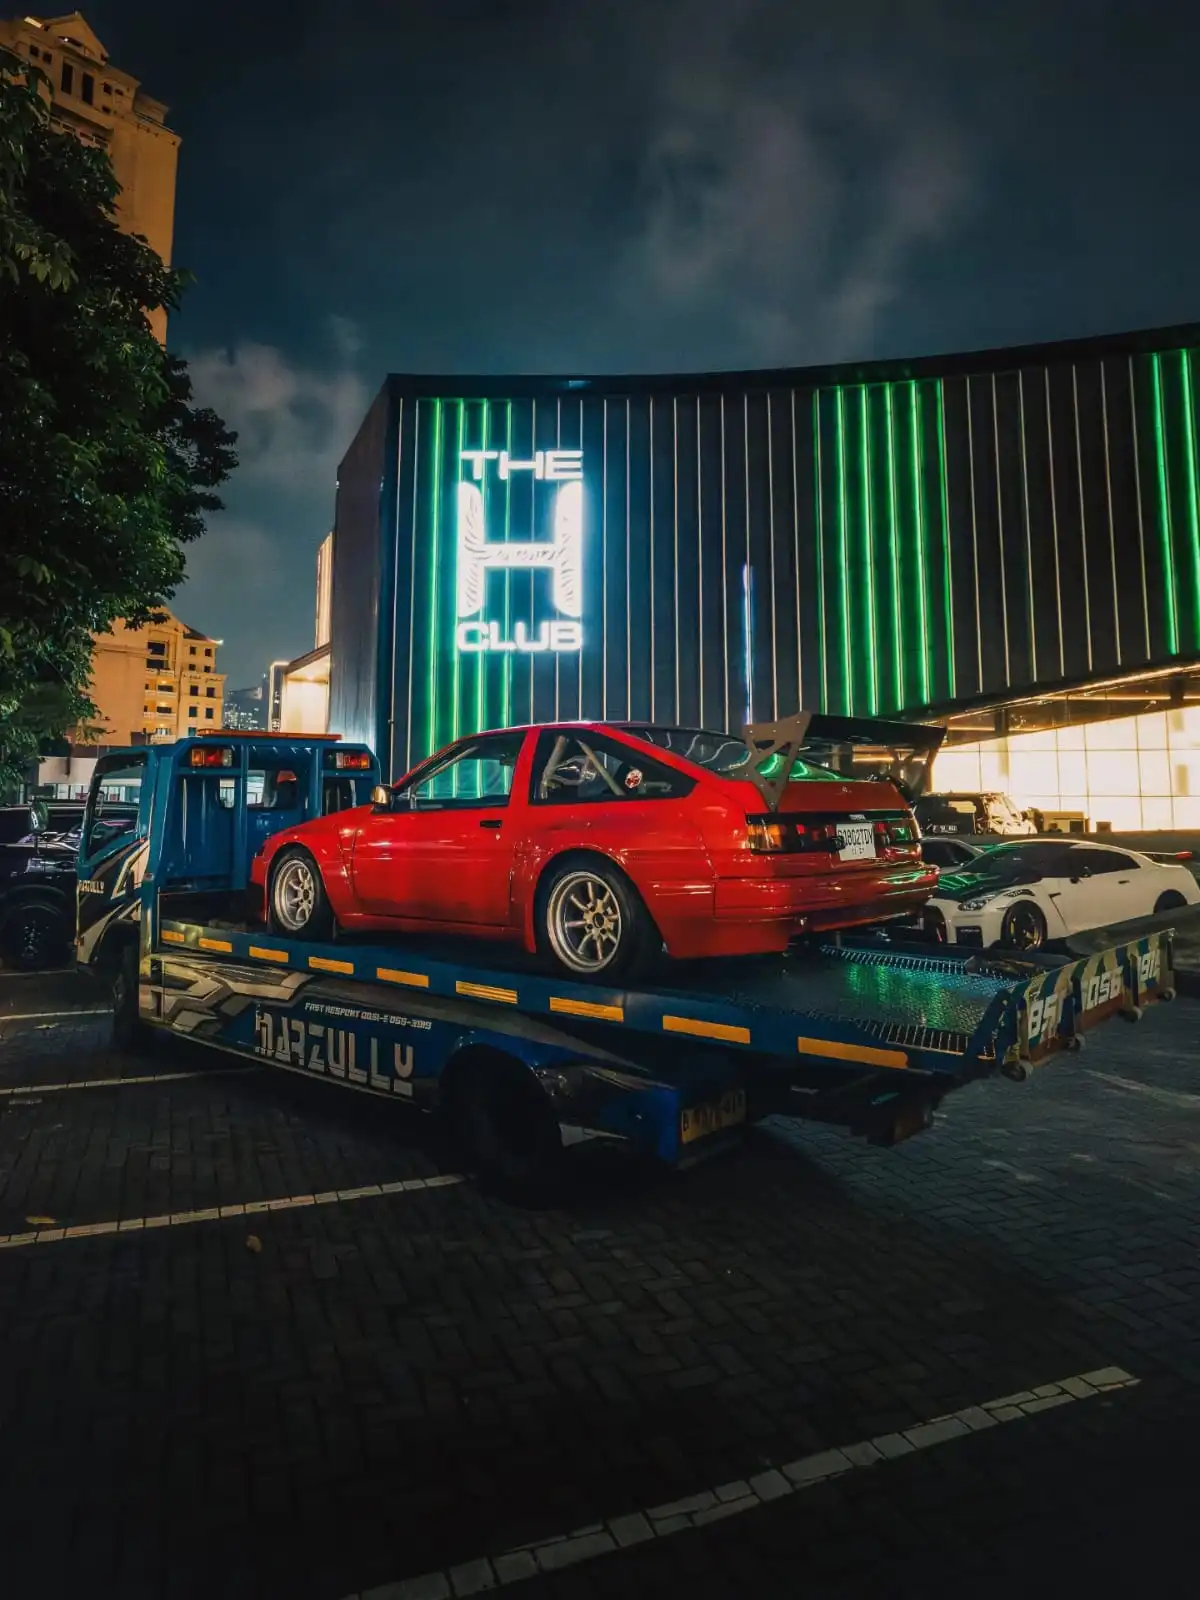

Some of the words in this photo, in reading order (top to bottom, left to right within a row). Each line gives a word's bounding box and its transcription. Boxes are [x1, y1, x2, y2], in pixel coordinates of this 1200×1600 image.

[460, 451, 583, 480] THE
[457, 481, 583, 618] H
[457, 621, 582, 651] CLUB
[304, 1002, 325, 1013] FAST
